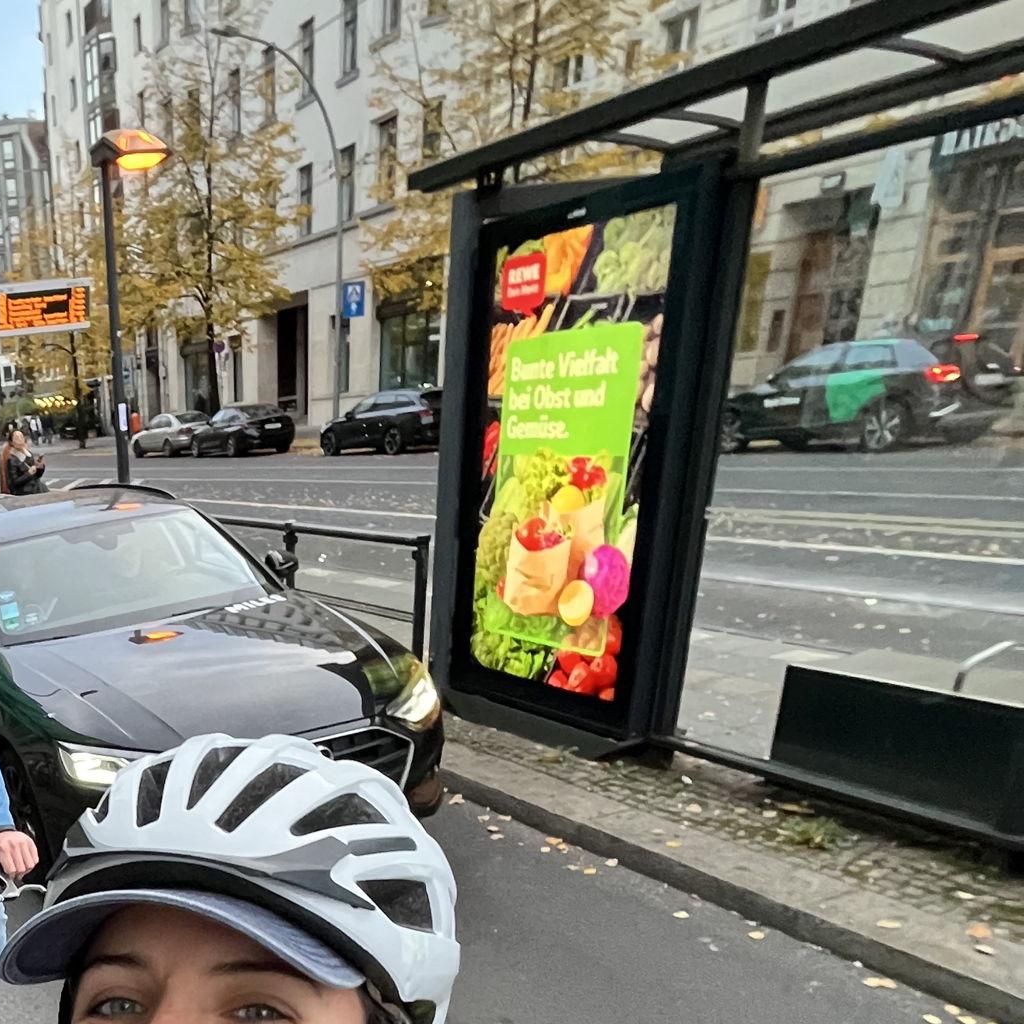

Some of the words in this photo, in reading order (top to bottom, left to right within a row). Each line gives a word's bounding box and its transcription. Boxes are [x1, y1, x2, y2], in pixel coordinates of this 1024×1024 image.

[508, 262, 540, 285] REWE
[511, 356, 555, 382] Bunte
[558, 346, 619, 378] Vielfalt
[508, 385, 532, 411] bei
[534, 384, 572, 410] Obst
[573, 379, 607, 409] und
[506, 415, 570, 440] Gemüse.
